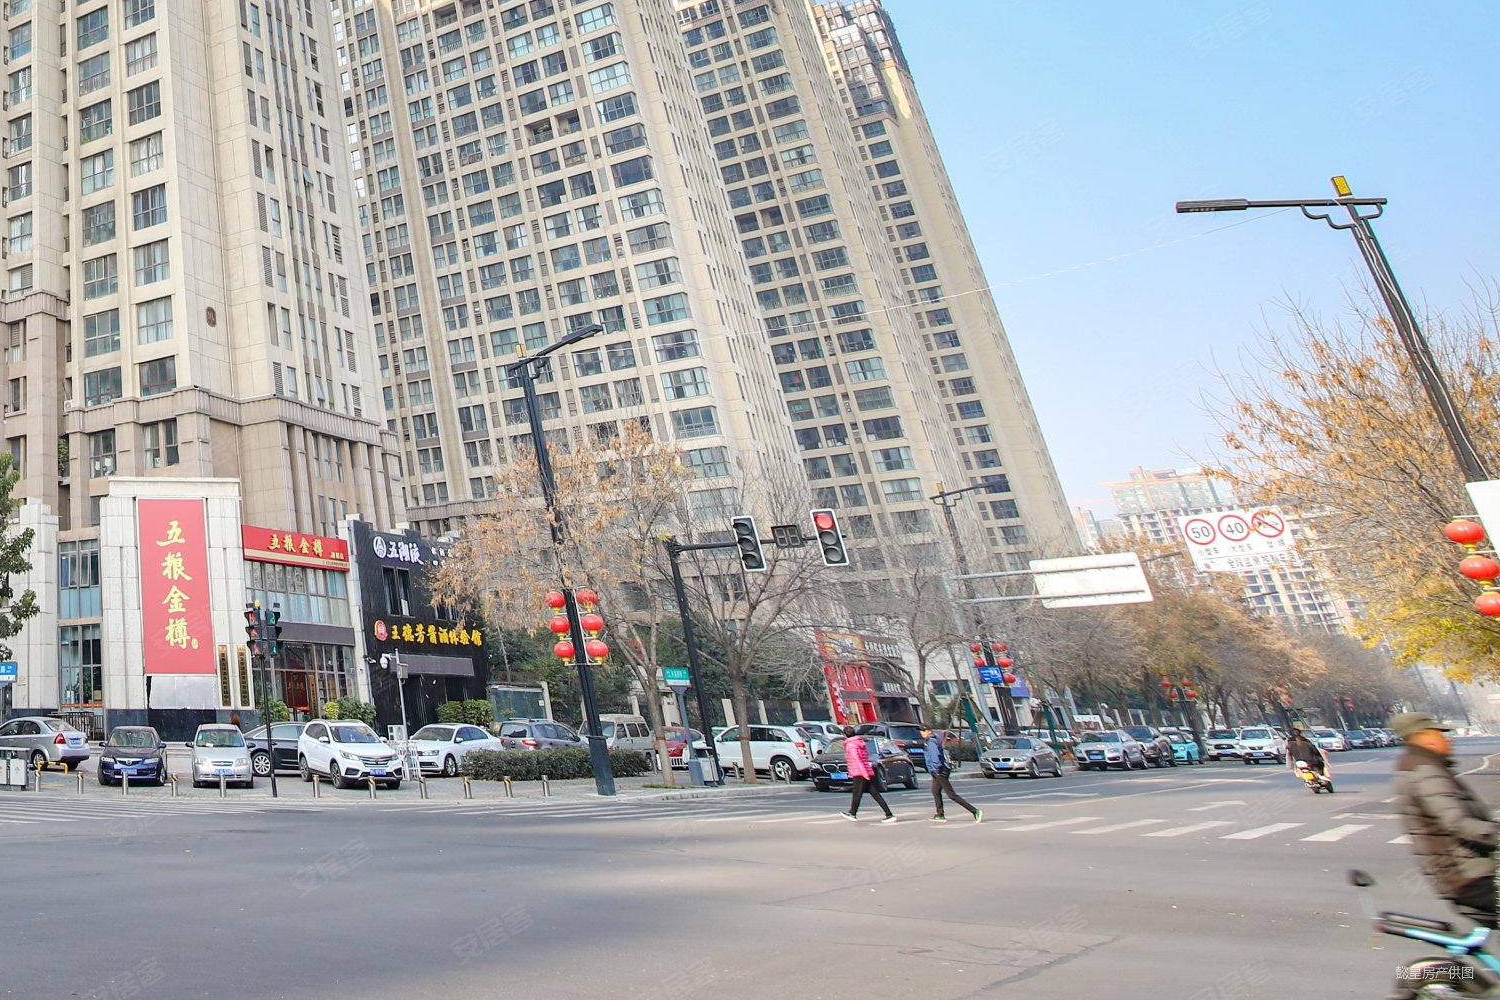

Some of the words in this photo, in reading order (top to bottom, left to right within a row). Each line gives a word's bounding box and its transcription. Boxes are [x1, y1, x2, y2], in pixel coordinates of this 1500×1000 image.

[1191, 526, 1210, 538] 50
[1226, 522, 1244, 534] 40
[268, 533, 323, 557] 五粮金樽
[155, 520, 193, 649] 五粮金樽
